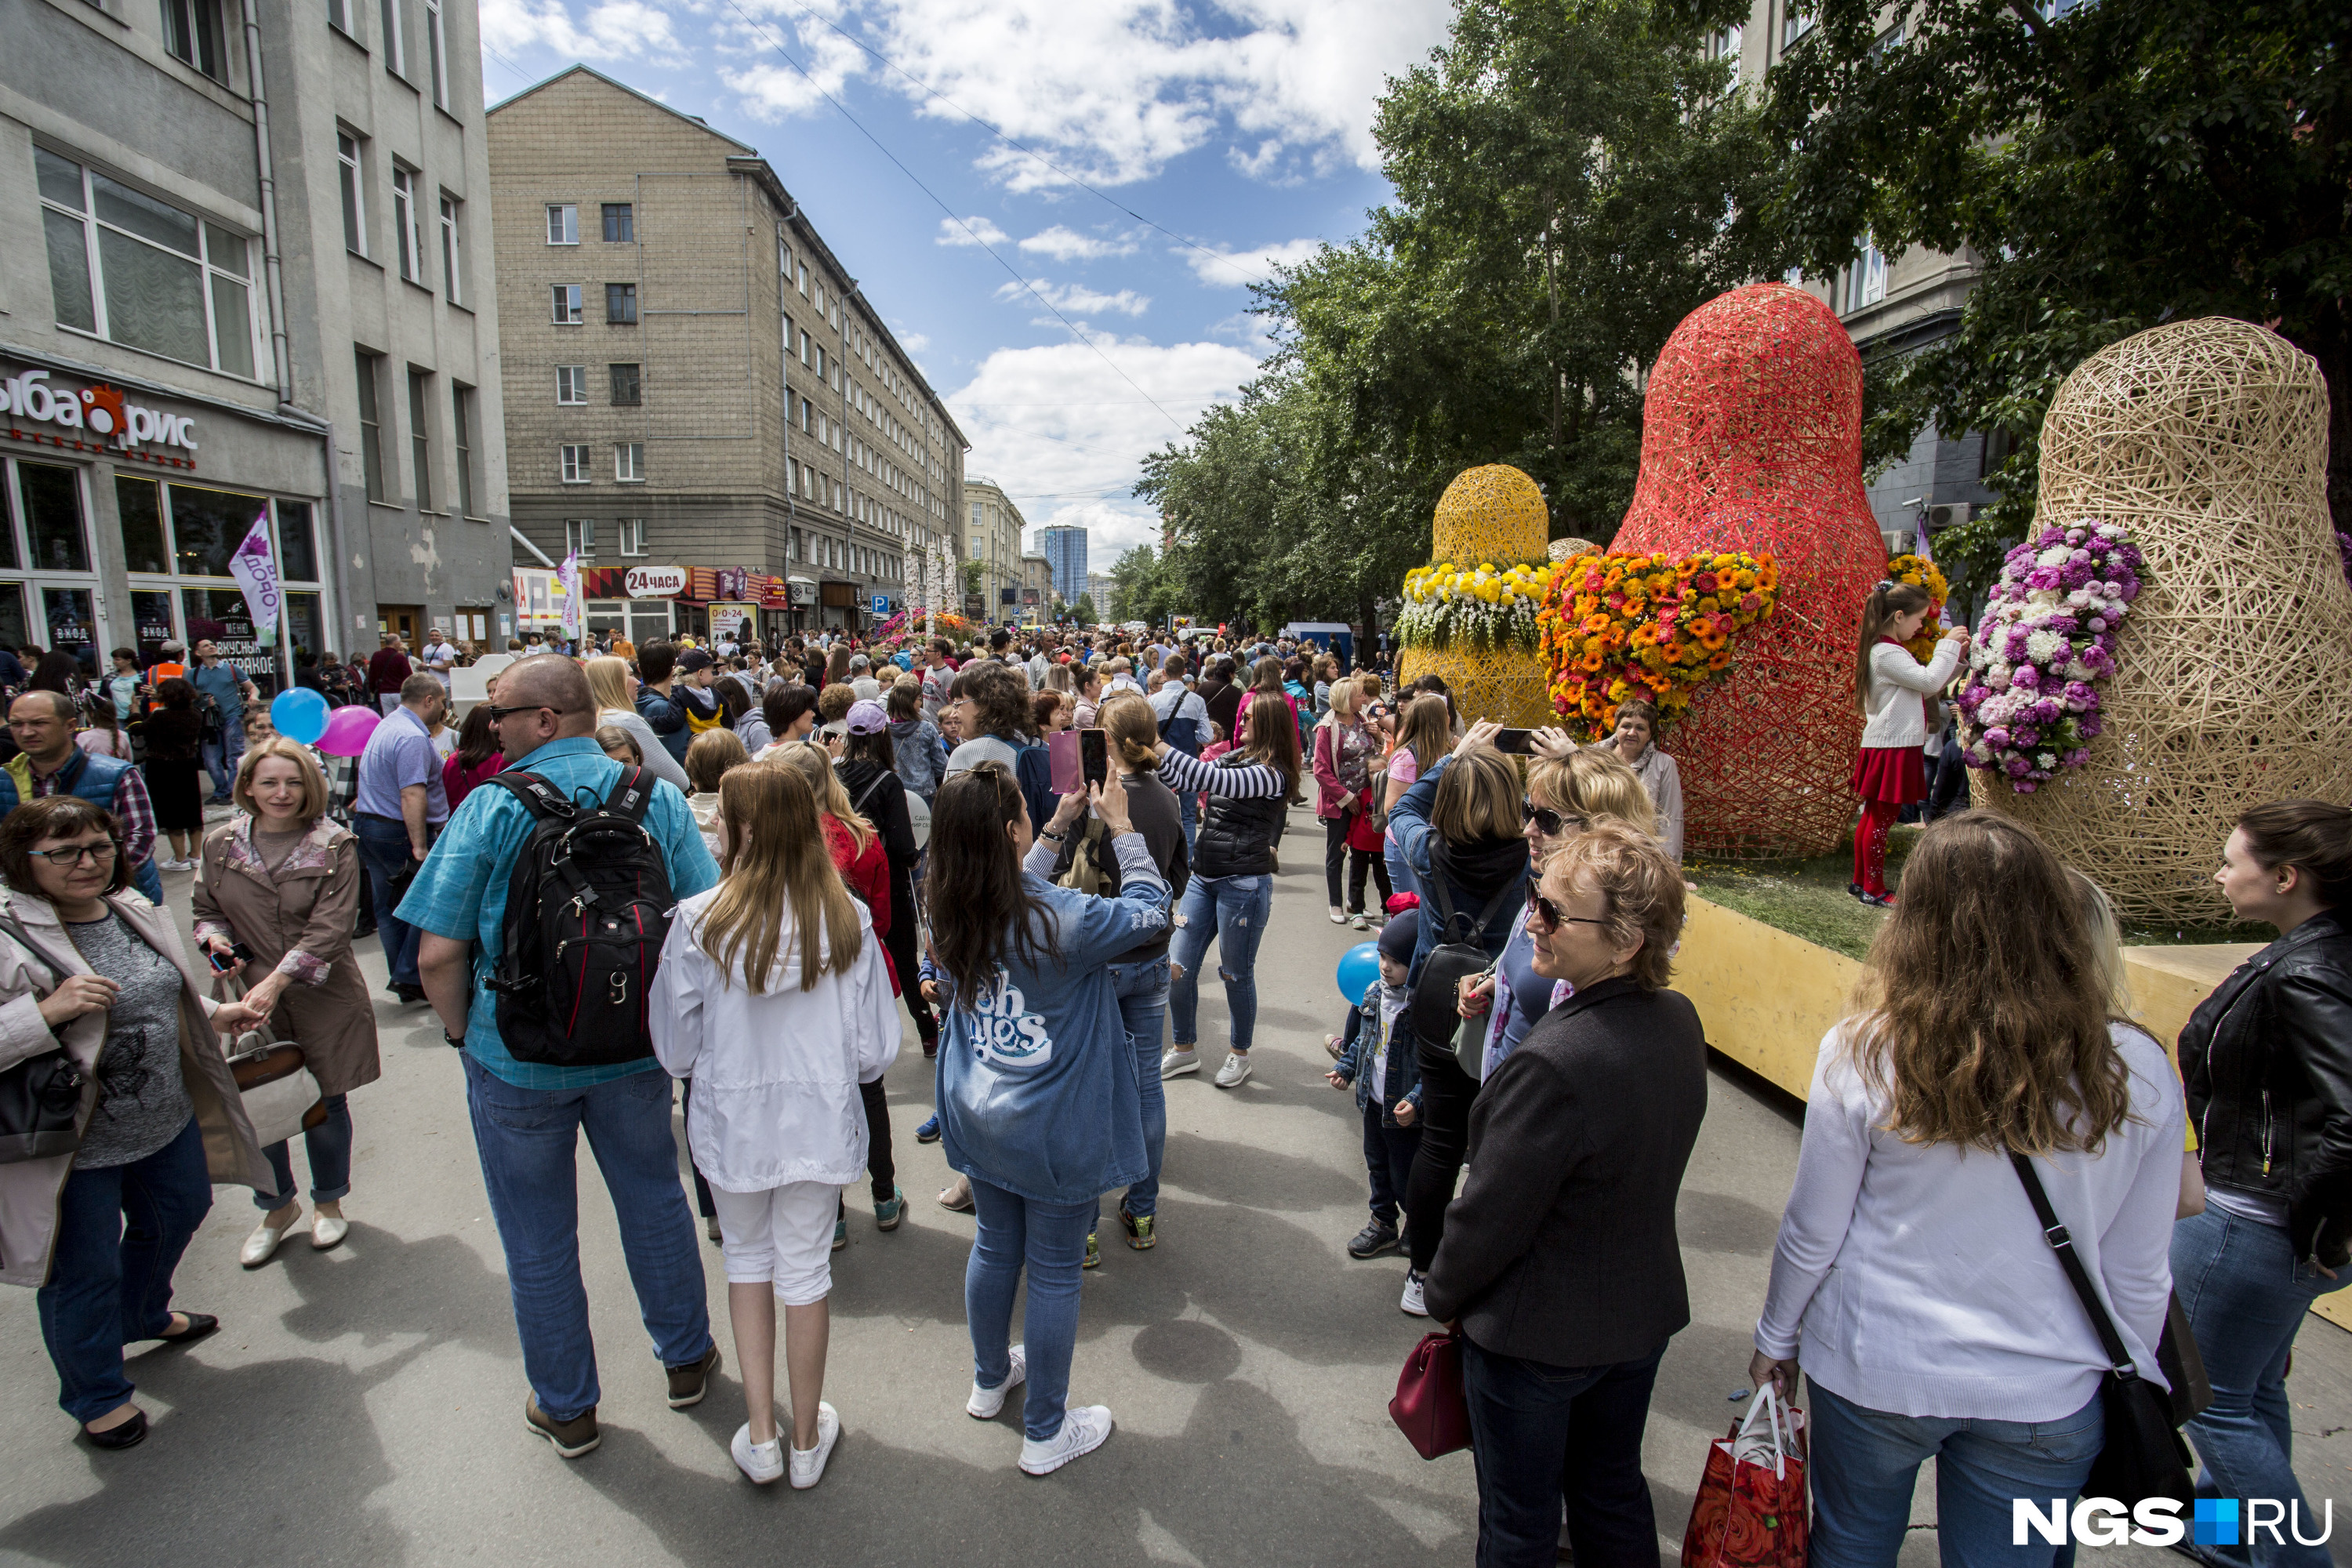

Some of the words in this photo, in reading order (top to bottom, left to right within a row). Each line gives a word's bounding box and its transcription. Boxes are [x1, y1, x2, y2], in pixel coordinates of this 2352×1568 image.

[124, 404, 198, 450] рис
[125, 449, 196, 470] КУХНЯ
[628, 572, 648, 590] 24
[649, 575, 681, 589] ЧАСА
[875, 597, 885, 612] P
[56, 628, 89, 640] ВХОД
[143, 626, 169, 638] ВХОД
[226, 622, 249, 634] МЕНЮ
